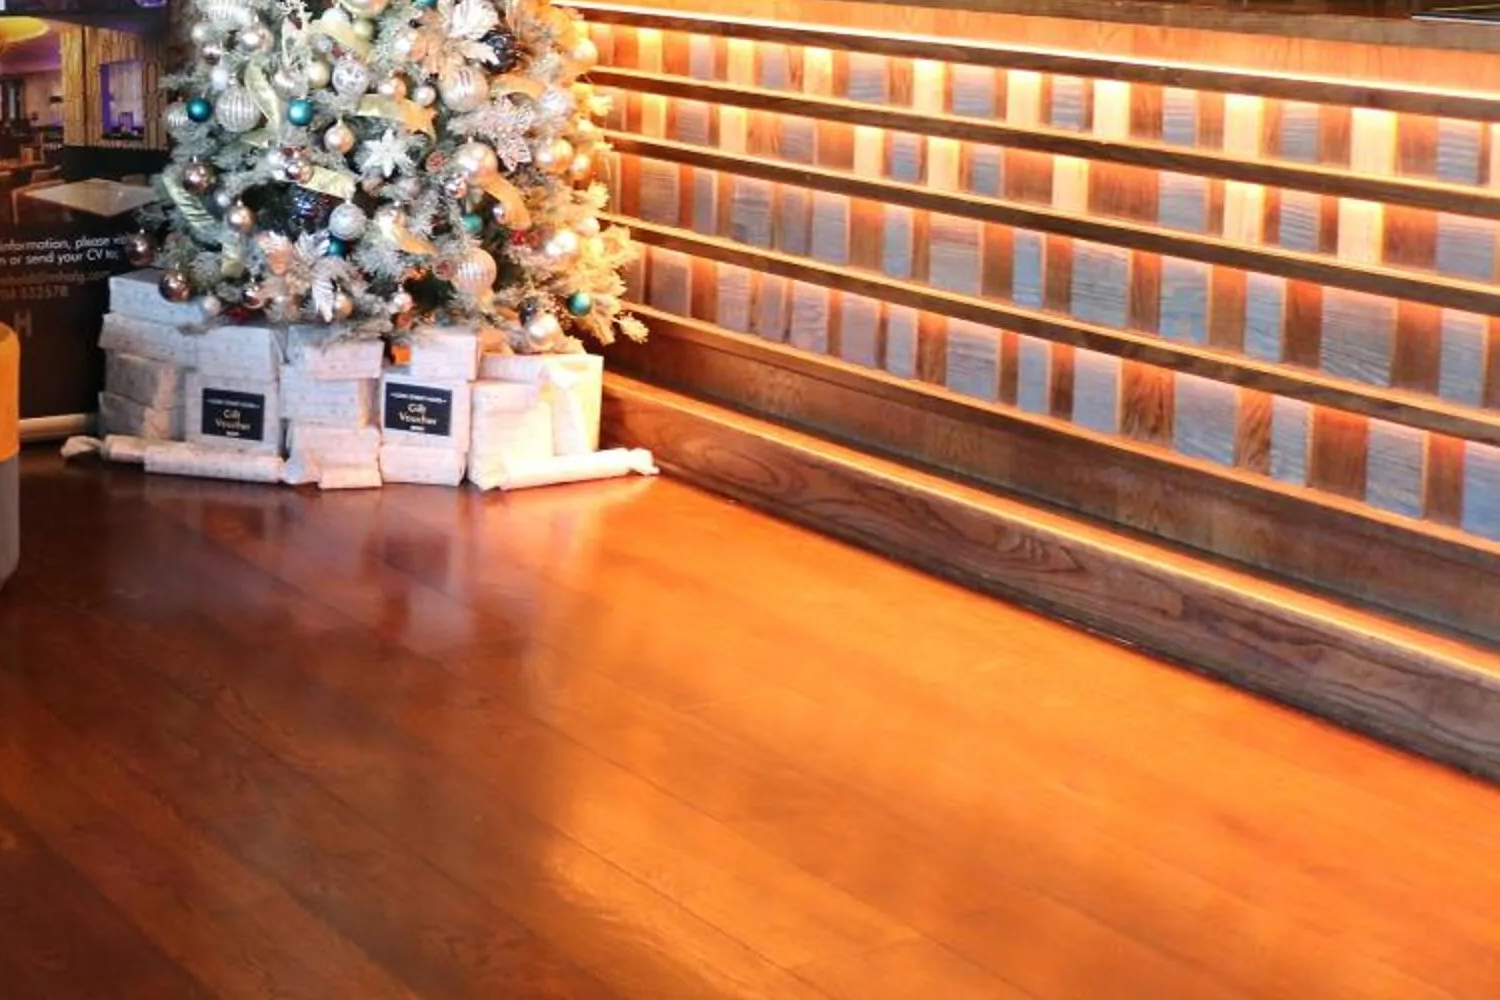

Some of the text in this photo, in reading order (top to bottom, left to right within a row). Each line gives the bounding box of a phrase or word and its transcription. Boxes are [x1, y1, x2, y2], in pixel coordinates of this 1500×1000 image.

[0, 237, 72, 253] information,
[75, 236, 111, 249] please
[10, 254, 23, 266] or
[25, 252, 55, 265] send
[57, 252, 84, 266] your
[86, 249, 103, 261] CV
